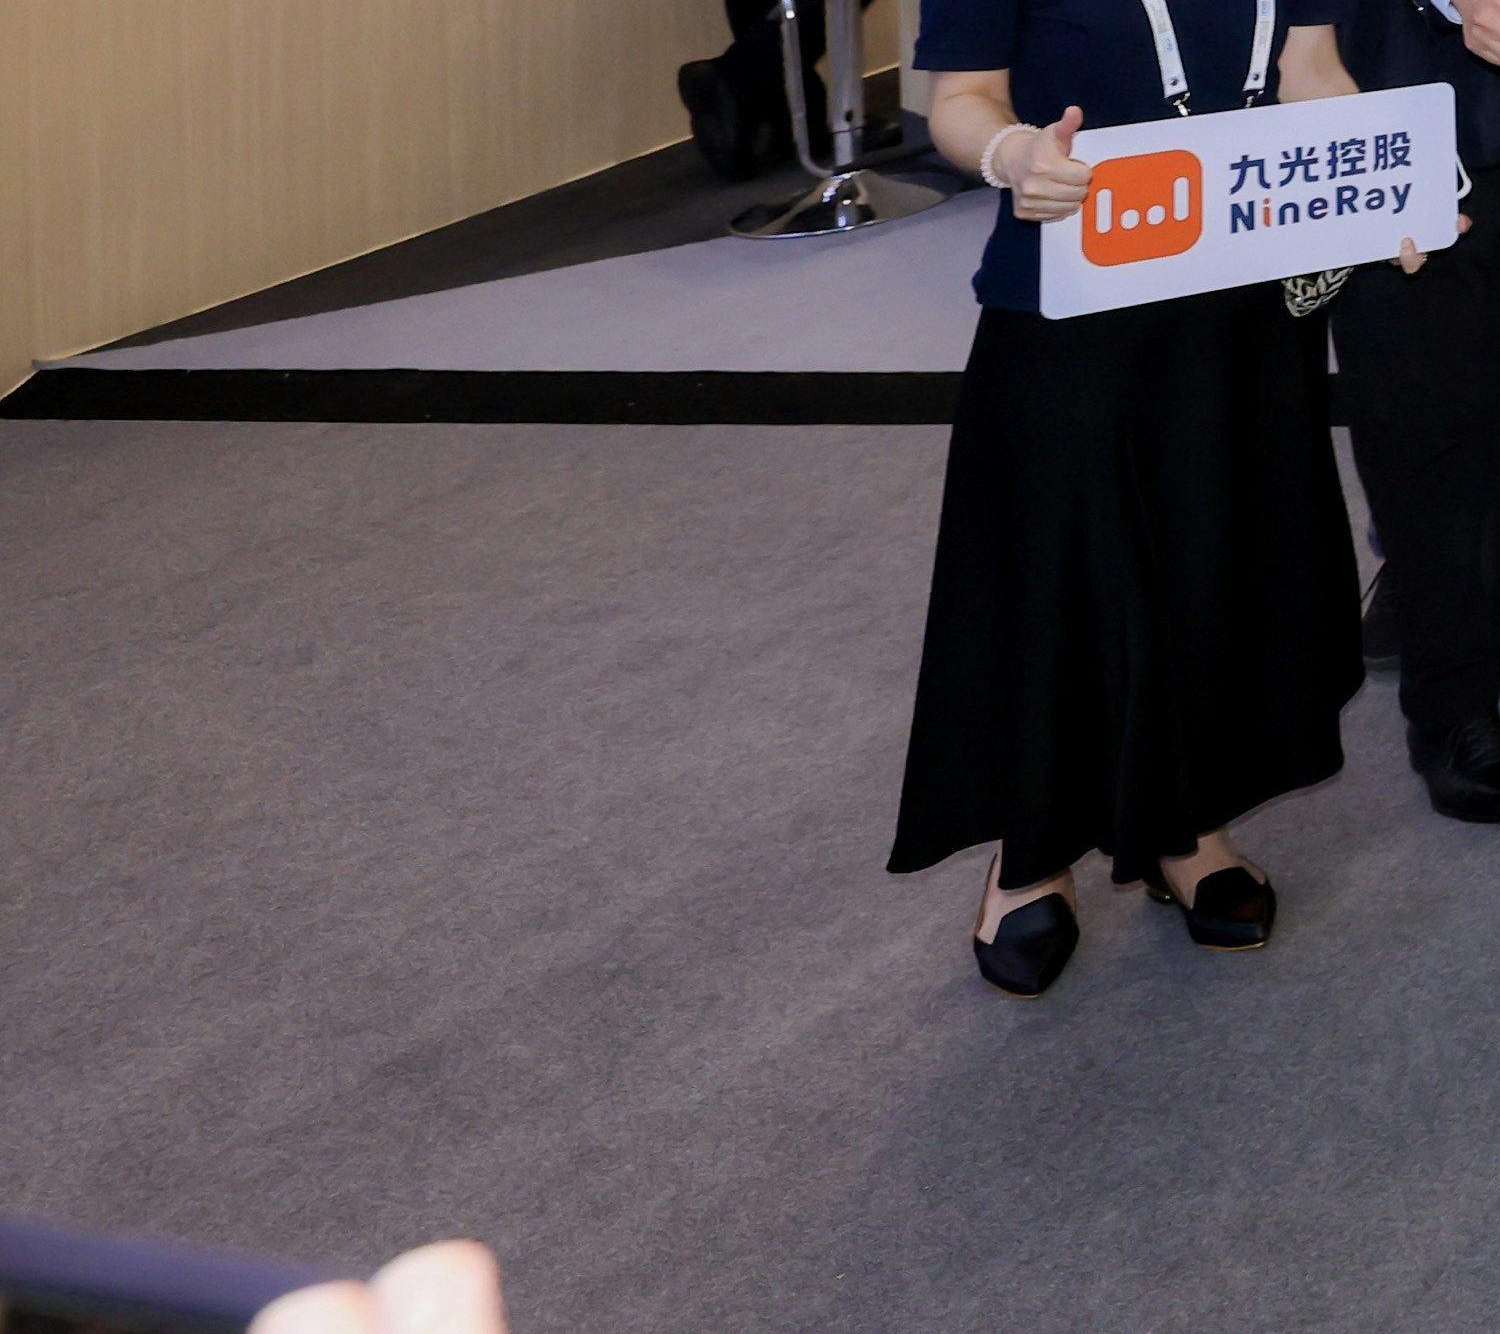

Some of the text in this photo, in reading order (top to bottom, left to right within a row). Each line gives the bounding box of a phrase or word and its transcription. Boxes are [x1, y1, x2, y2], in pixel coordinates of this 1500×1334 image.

[1229, 131, 1413, 196] 九光控股
[1229, 181, 1413, 234] NineRay
